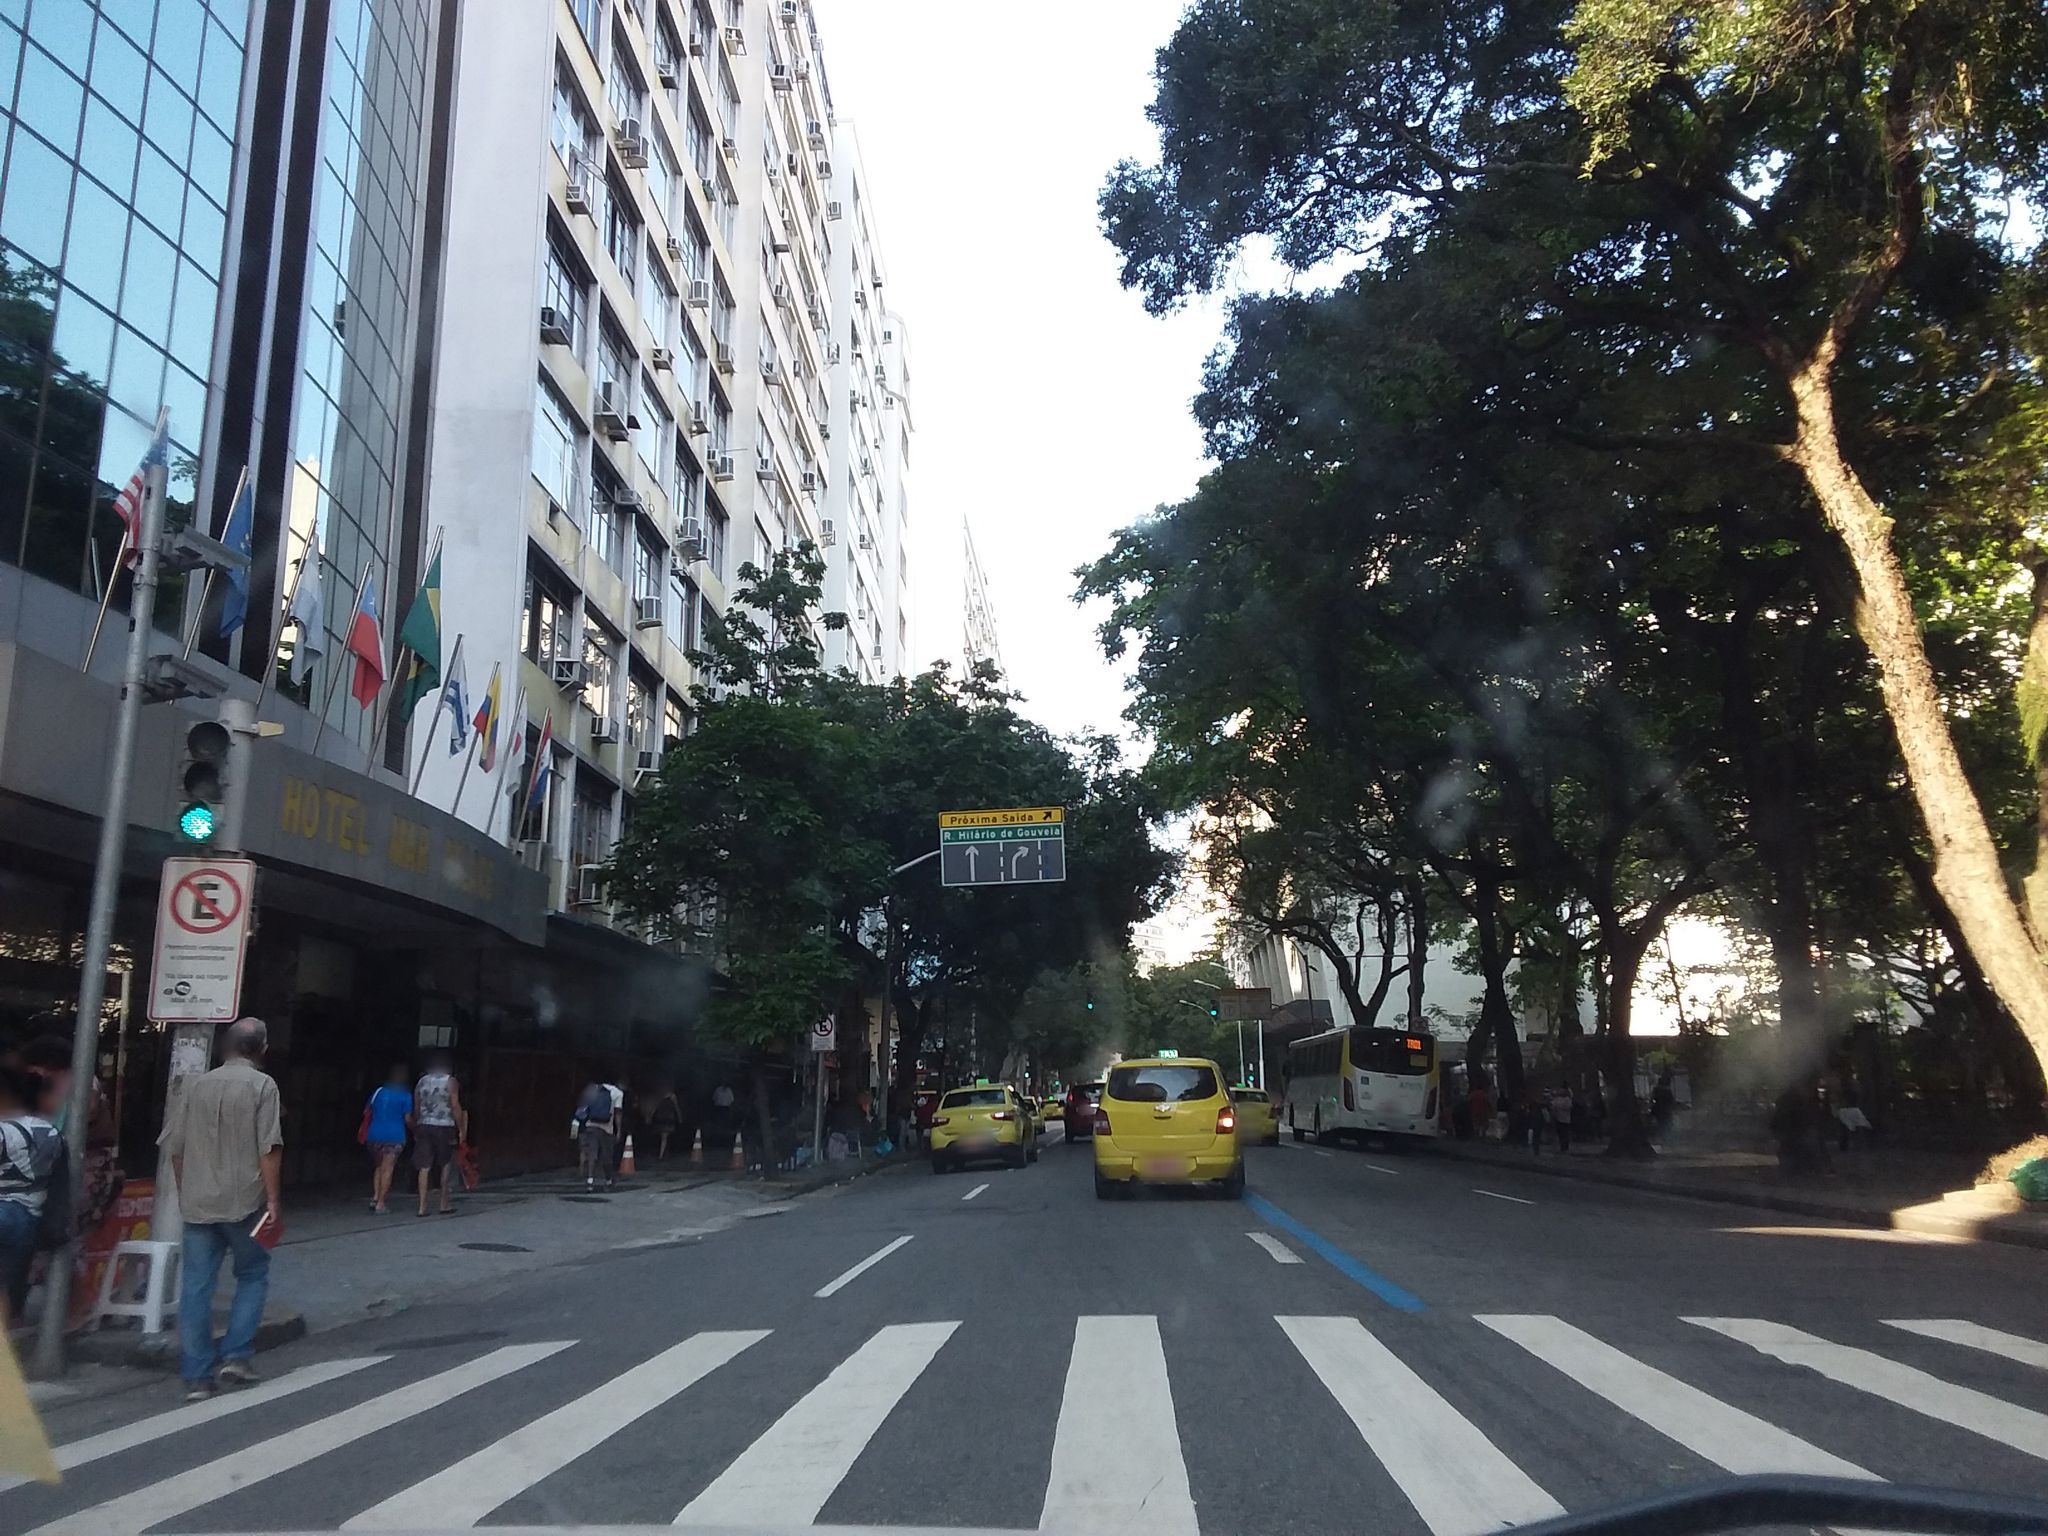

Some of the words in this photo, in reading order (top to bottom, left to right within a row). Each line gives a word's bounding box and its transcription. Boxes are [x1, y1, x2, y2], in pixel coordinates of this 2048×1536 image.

[283, 774, 371, 858] HOTEL
[950, 814, 998, 825] Próxima
[944, 831, 955, 841] R.
[958, 829, 996, 840] Hilário
[1001, 828, 1013, 838] de
[1017, 827, 1061, 838] Gouveia
